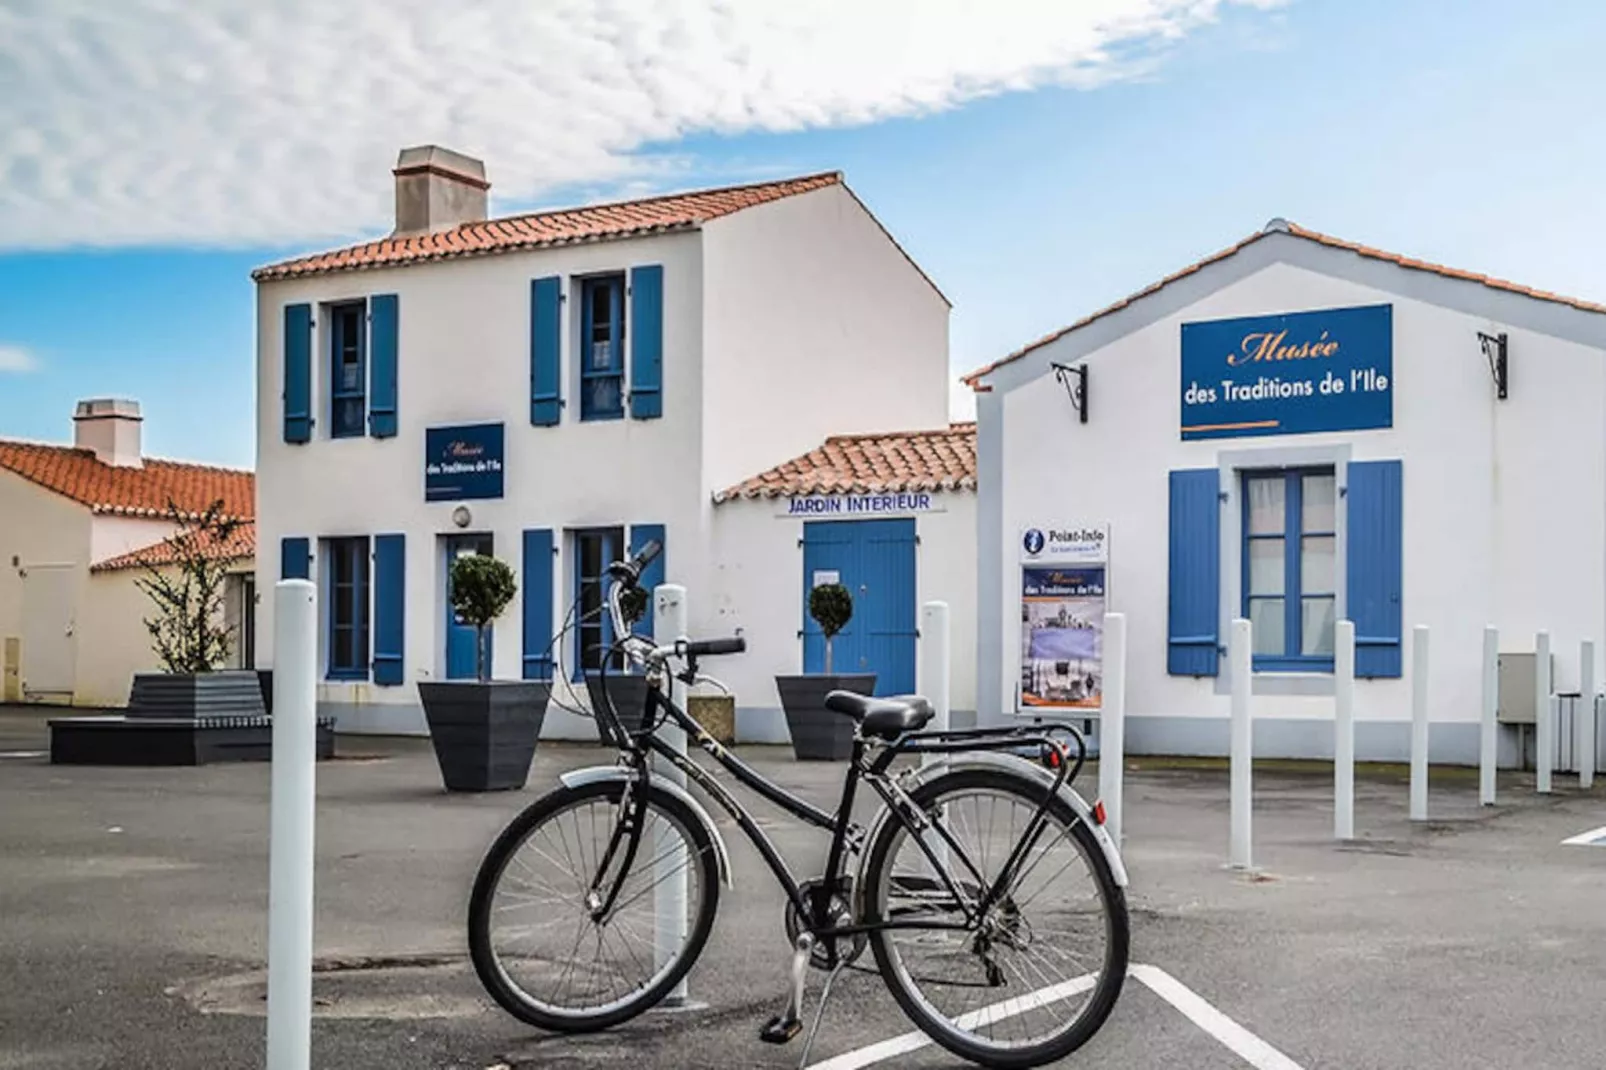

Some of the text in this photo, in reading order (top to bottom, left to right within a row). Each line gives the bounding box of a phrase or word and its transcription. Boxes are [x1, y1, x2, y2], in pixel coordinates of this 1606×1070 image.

[1226, 329, 1340, 367] Musée
[1184, 382, 1218, 404] des
[1221, 377, 1314, 401] Traditions
[1319, 372, 1345, 394] de
[441, 461, 475, 474] Traditions
[476, 460, 486, 472] de
[788, 494, 930, 514] JARDIN INTERIEUR
[1048, 529, 1104, 542] Point-Info
